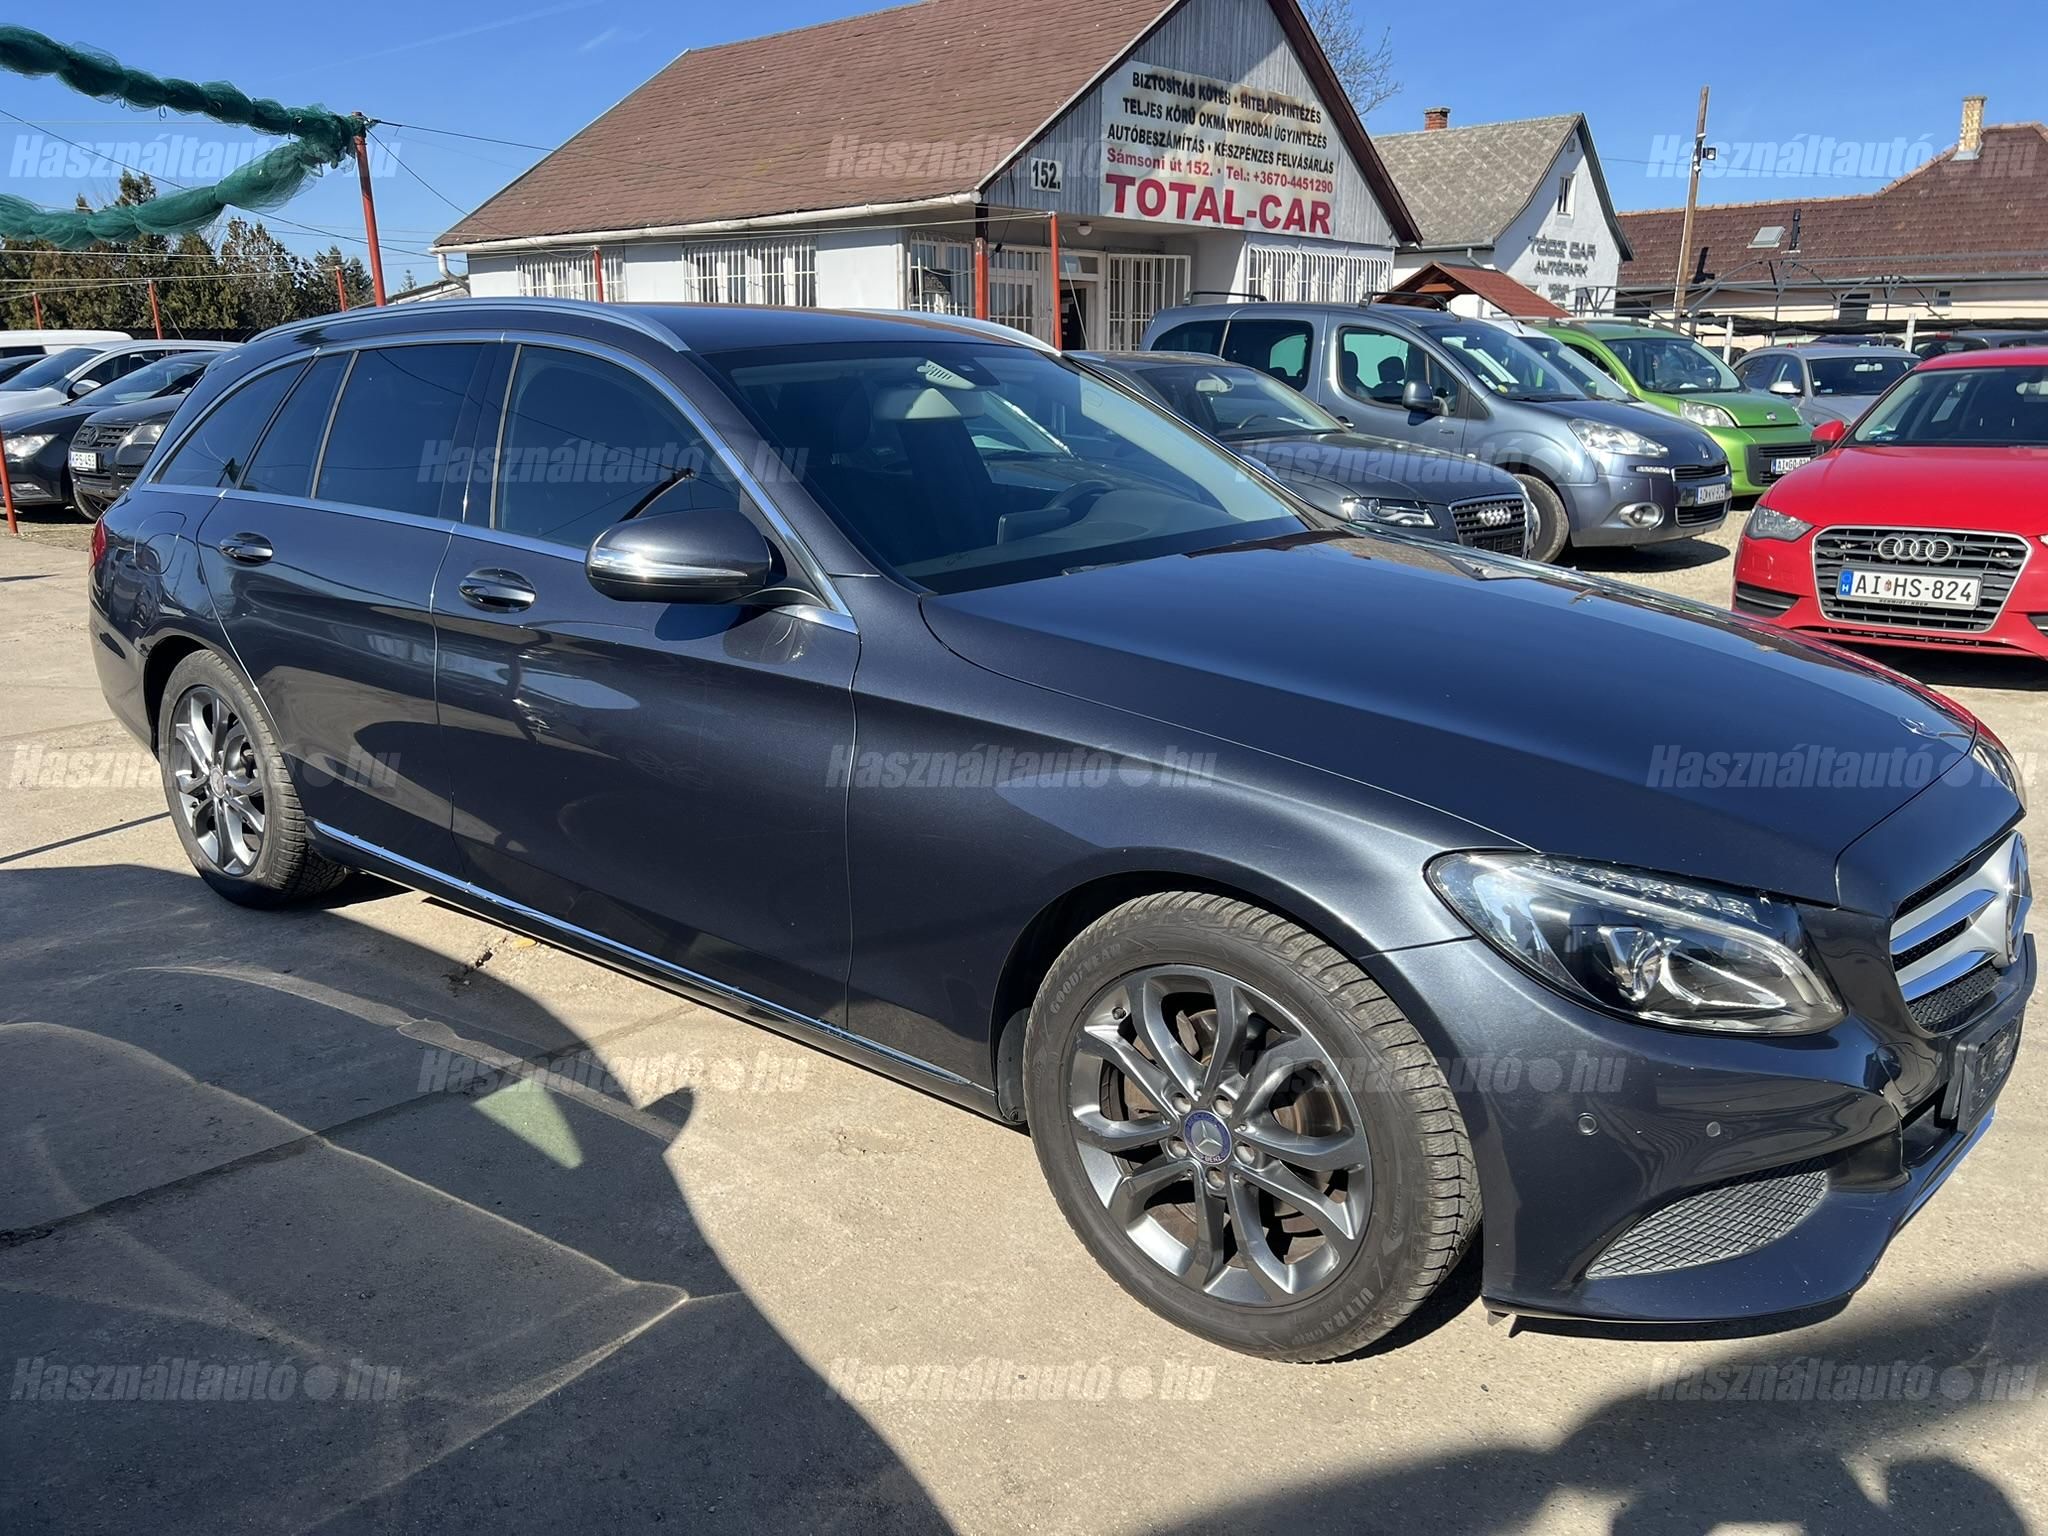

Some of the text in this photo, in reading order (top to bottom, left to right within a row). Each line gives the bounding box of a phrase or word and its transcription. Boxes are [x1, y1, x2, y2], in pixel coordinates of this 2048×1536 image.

[1122, 97, 1163, 120] TELJES
[1198, 112, 1273, 139] OKMÁNYIRODAI
[1274, 124, 1327, 149] ÜGYINTÉZÉS
[1132, 72, 1321, 124] BIZTOSÍTÁS KÖTÉS HITELÜGYINTÉZÉS
[1107, 124, 1205, 153] AUTÓBESZÁMÍTÁS
[1214, 140, 1274, 165] KÉSZPÉNZES
[1276, 153, 1334, 174] FELVÁSÁRLÁS
[1107, 148, 1165, 169] Sámsoni
[1169, 156, 1182, 172] út
[1186, 160, 1213, 176] 152.
[1226, 165, 1250, 182] Tel.:
[1032, 160, 1060, 190] 152.
[1105, 173, 1331, 235] TOTAL-CAR
